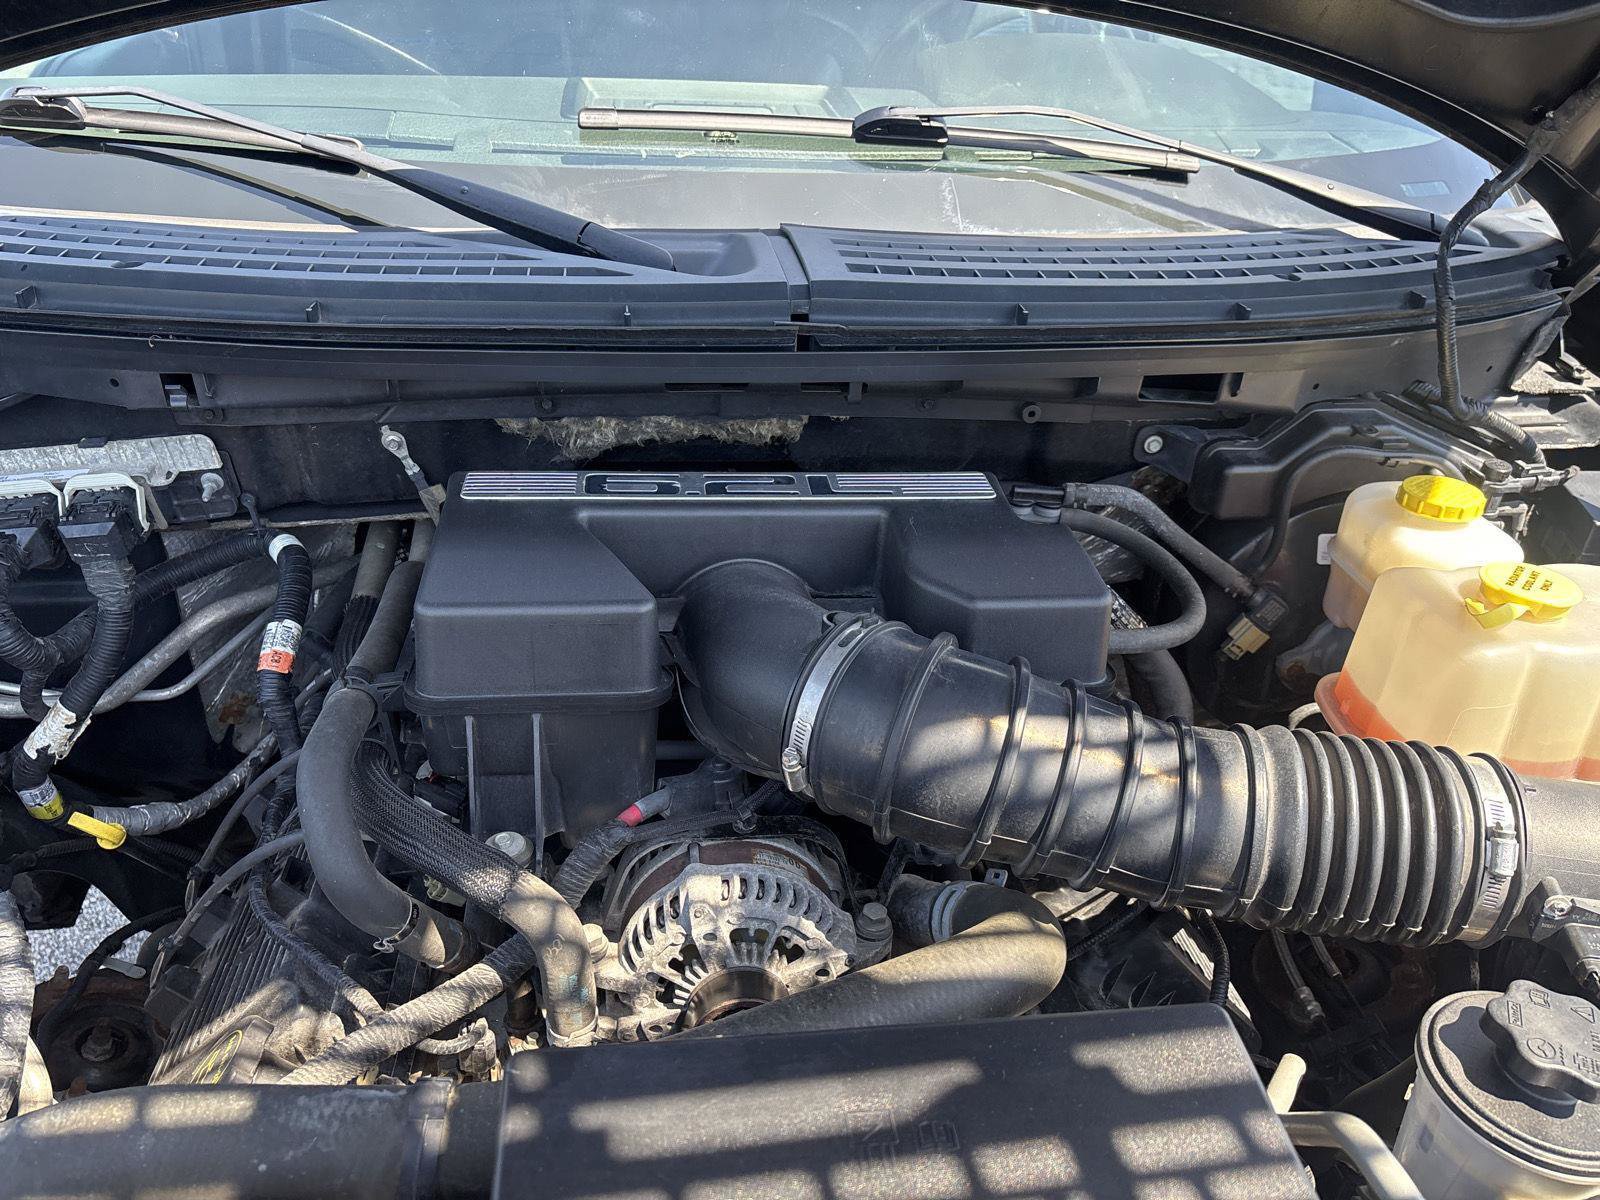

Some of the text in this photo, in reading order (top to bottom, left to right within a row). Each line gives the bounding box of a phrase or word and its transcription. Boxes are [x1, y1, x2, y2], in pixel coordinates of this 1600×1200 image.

[583, 473, 893, 497] 6.2L
[1506, 566, 1525, 586] RADIATOR
[1522, 571, 1540, 590] COOLANT
